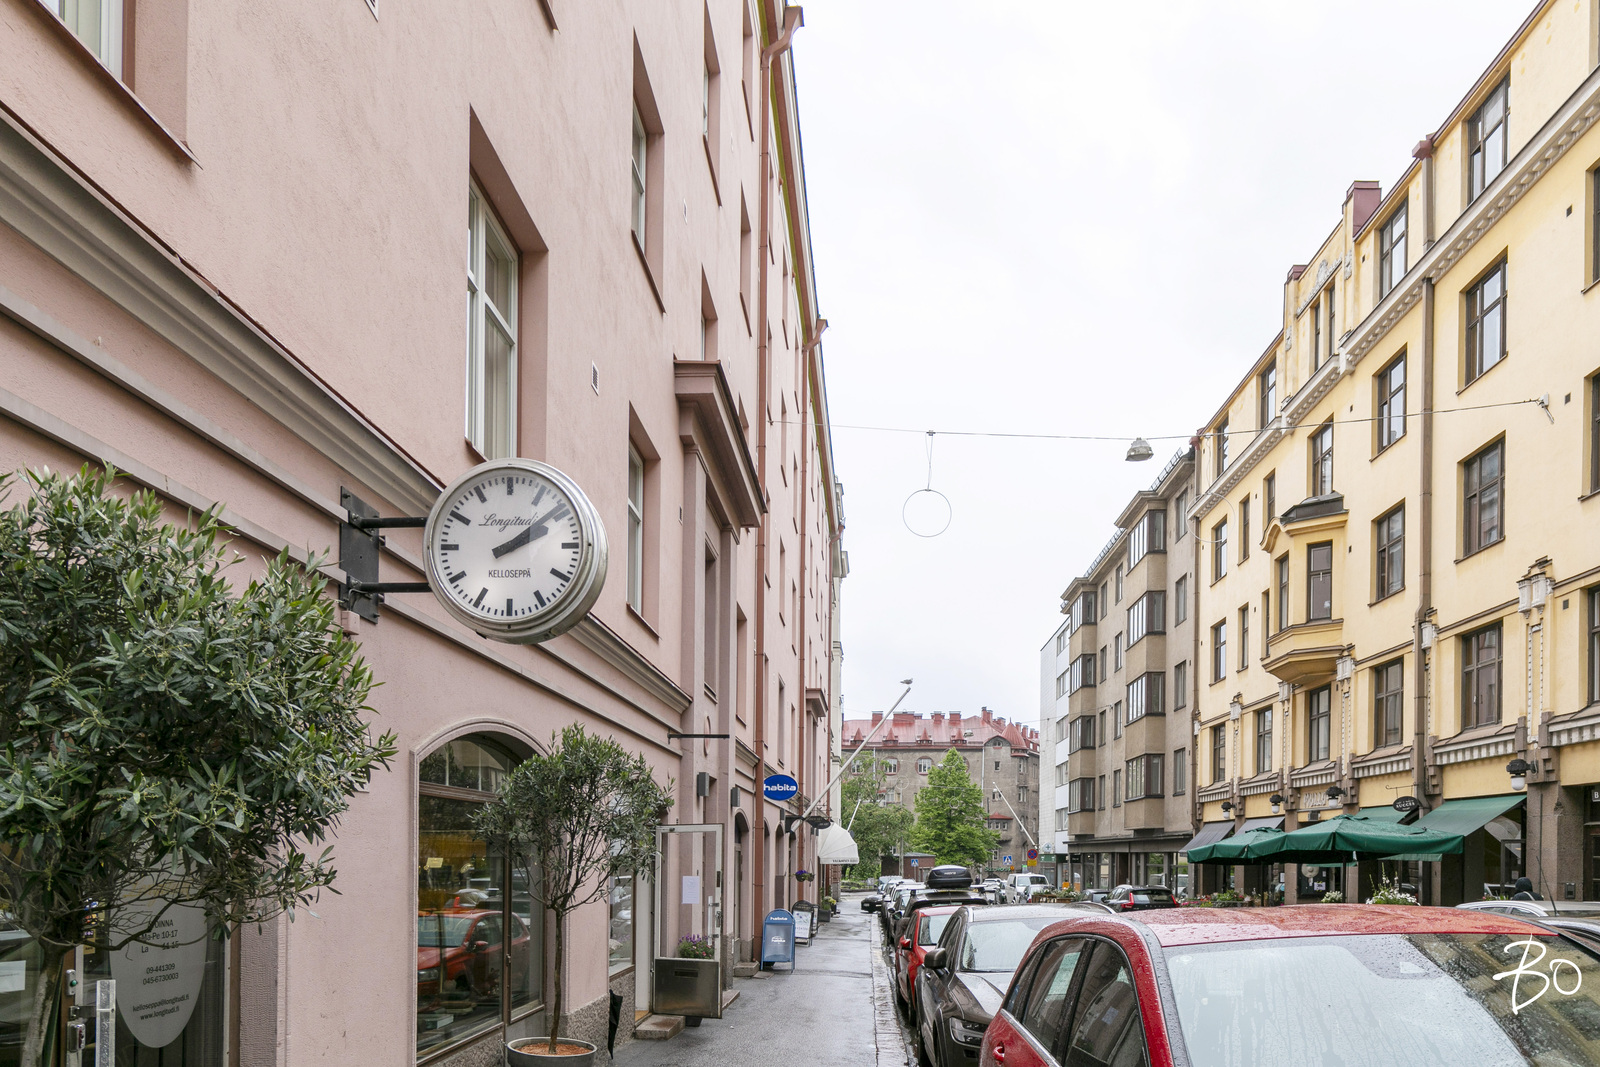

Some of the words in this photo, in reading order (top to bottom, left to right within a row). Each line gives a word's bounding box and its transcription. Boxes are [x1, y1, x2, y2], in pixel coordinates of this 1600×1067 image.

[488, 568, 531, 578] KELLOSEPPÄ
[763, 783, 797, 791] habita
[161, 930, 178, 939] 10-17
[146, 963, 175, 974] 09-441309
[142, 973, 179, 985] 045-6730003
